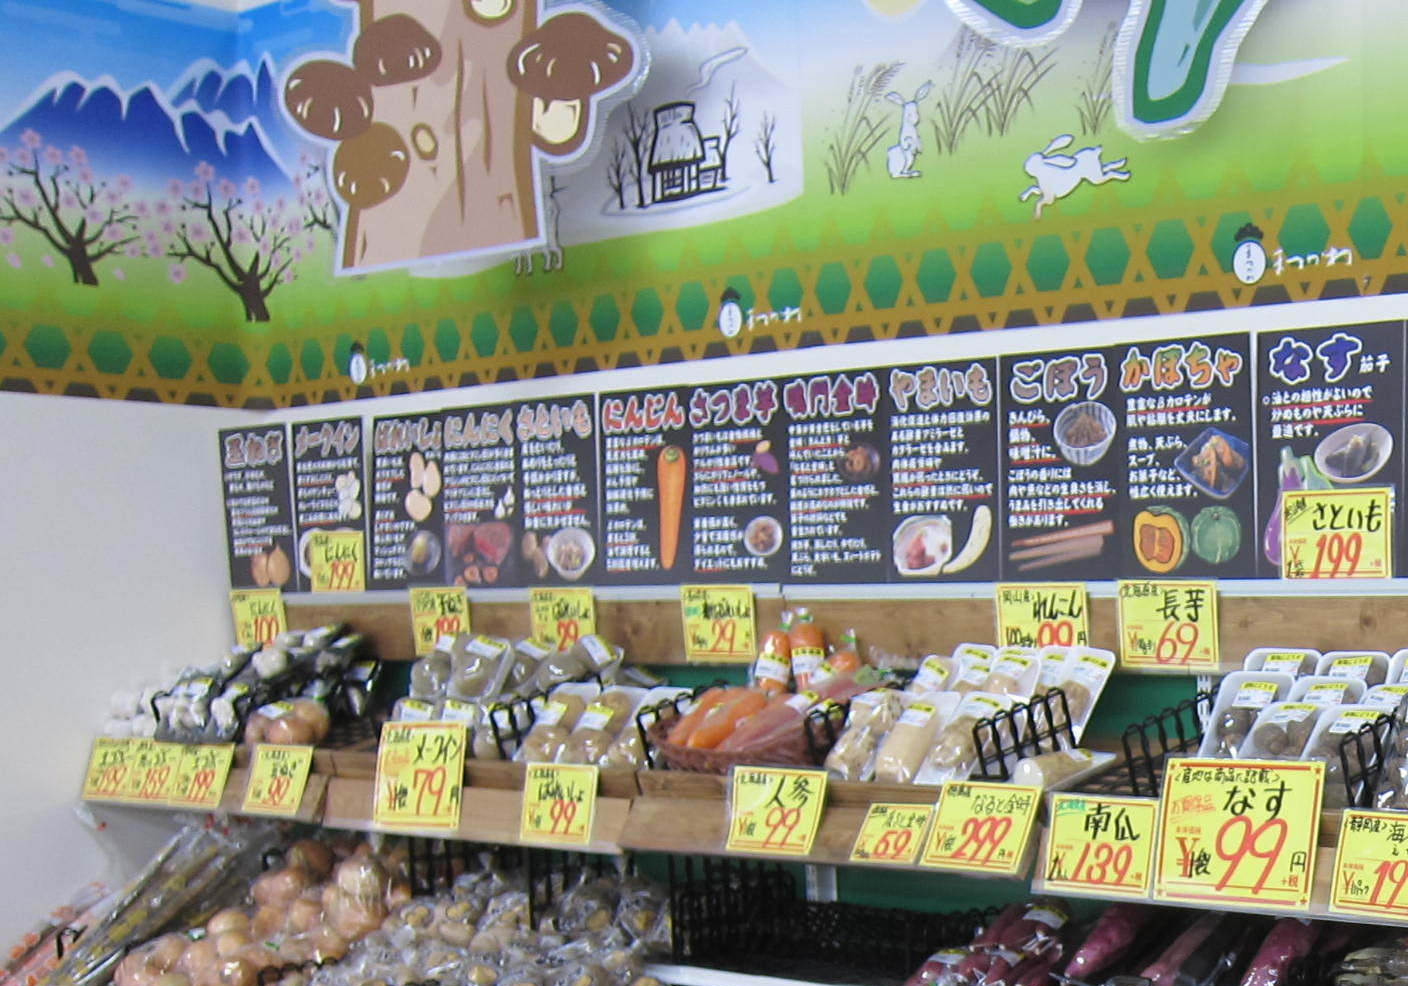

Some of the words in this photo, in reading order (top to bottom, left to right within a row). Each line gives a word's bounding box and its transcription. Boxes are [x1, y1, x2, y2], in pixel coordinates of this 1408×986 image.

[1009, 352, 1109, 405] ごぼう
[1118, 341, 1244, 393] かぼちゃ
[1269, 332, 1363, 386] なす
[1359, 352, 1392, 374] 茄子
[889, 362, 992, 413] やまいも
[602, 391, 686, 434] にんじん
[1312, 499, 1383, 533] さといも
[1308, 532, 1363, 579] 199
[1156, 589, 1205, 622] 長芋
[710, 619, 737, 655] 29
[1155, 620, 1199, 665] 69
[412, 766, 446, 817] 79
[764, 774, 816, 811] 人参
[1222, 780, 1293, 822] なす
[549, 799, 578, 834] 99
[762, 806, 801, 848] 99
[1084, 802, 1139, 841] 南瓜
[951, 816, 1013, 865] 299
[1214, 814, 1288, 895] 99
[1290, 850, 1307, 873] 円
[1070, 842, 1133, 884] 139
